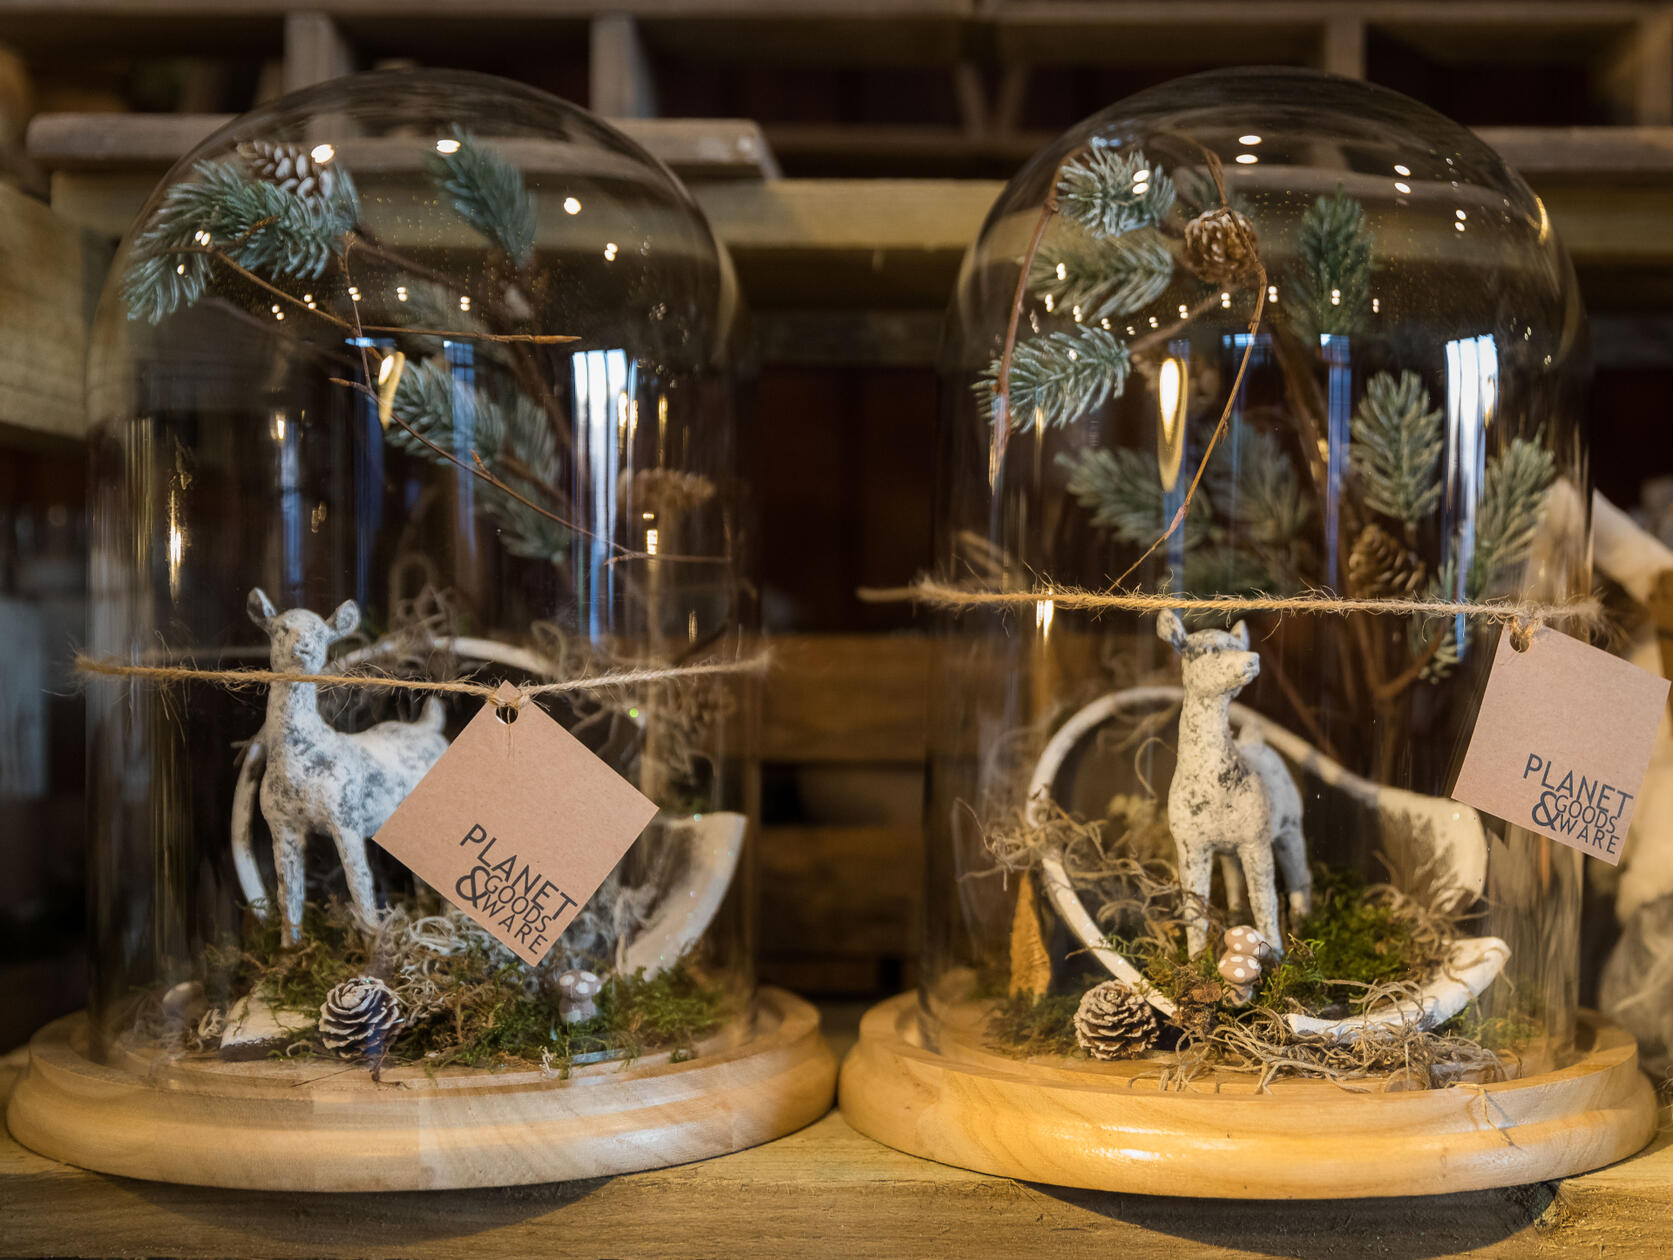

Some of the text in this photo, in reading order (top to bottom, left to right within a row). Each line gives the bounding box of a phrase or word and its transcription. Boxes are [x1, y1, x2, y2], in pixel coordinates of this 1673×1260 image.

[1523, 753, 1634, 818] PLANET
[1555, 795, 1618, 834] GOODS
[1560, 814, 1620, 854] WARE
[459, 823, 578, 920] PLANET
[481, 894, 548, 955] WARE
[484, 875, 552, 933] GOODS
